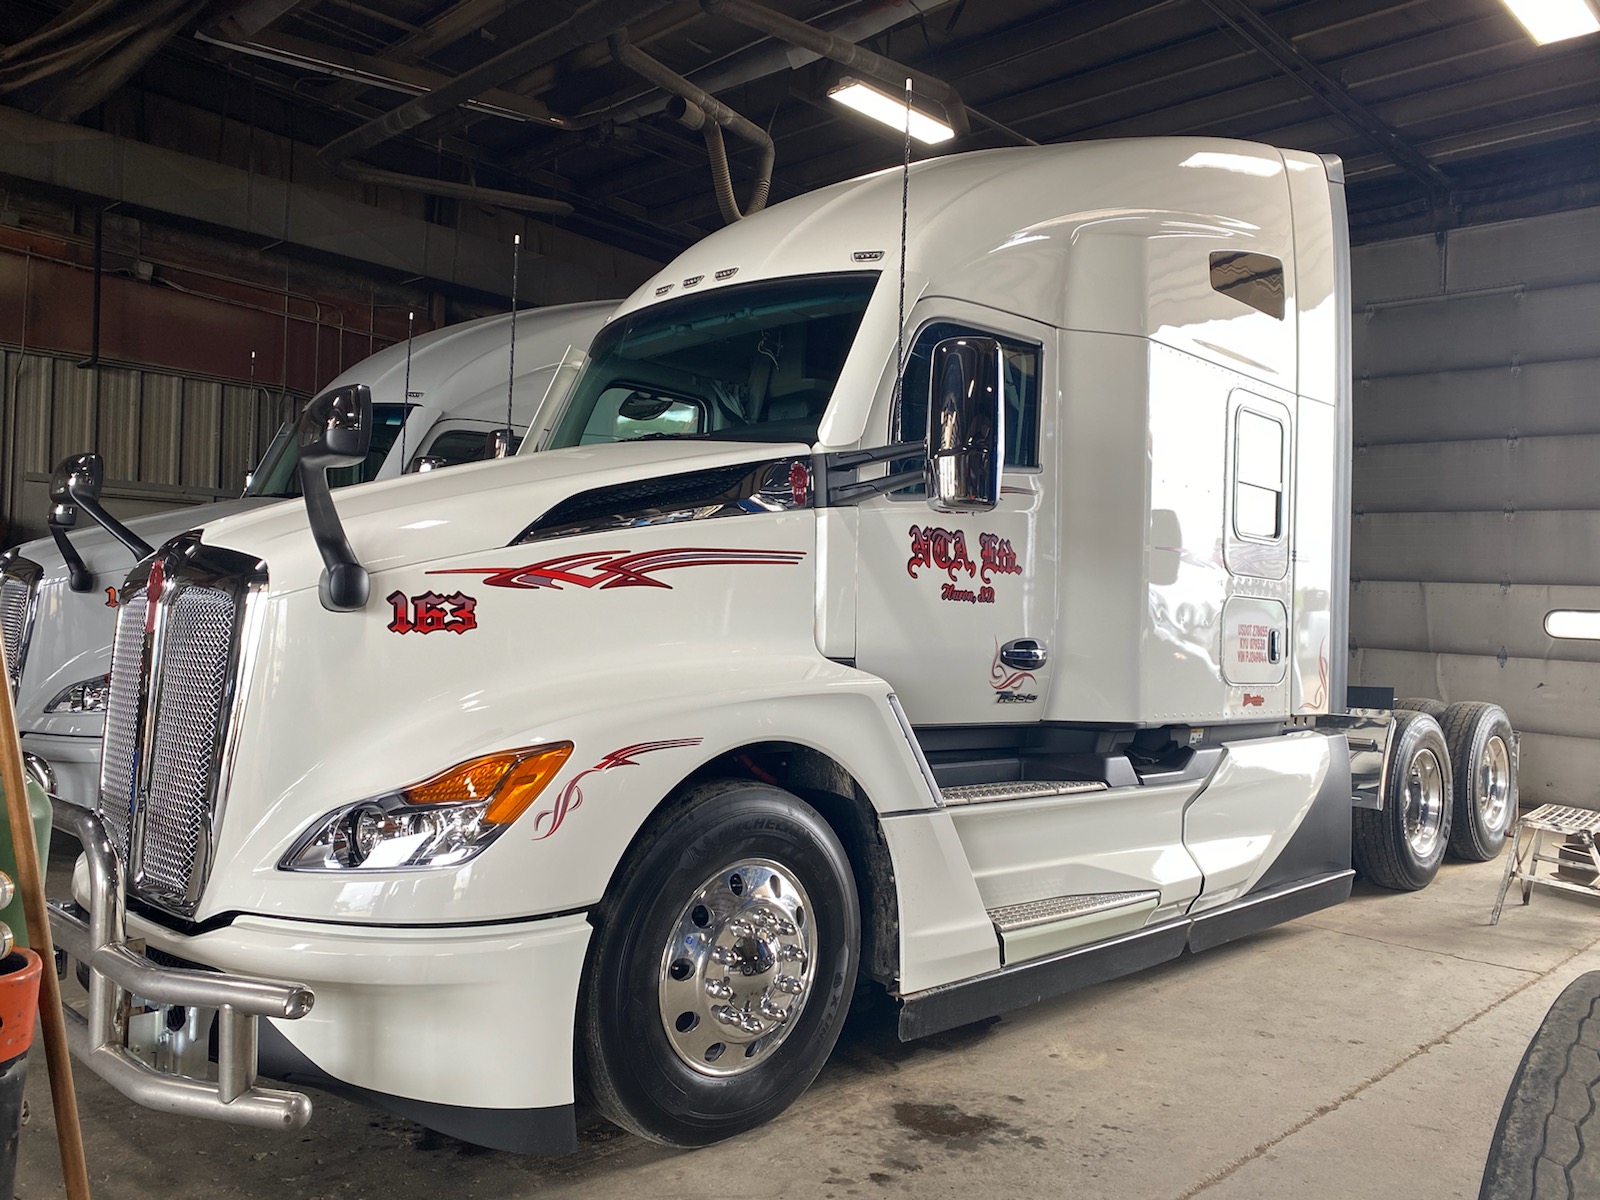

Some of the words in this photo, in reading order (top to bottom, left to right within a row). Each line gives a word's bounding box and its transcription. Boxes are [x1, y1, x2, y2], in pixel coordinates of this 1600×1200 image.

[979, 532, 1023, 584] Ltd.
[941, 583, 976, 604] Huron,
[386, 590, 478, 635] 163
[1238, 624, 1252, 637] USDOT
[1240, 638, 1249, 650] KYU
